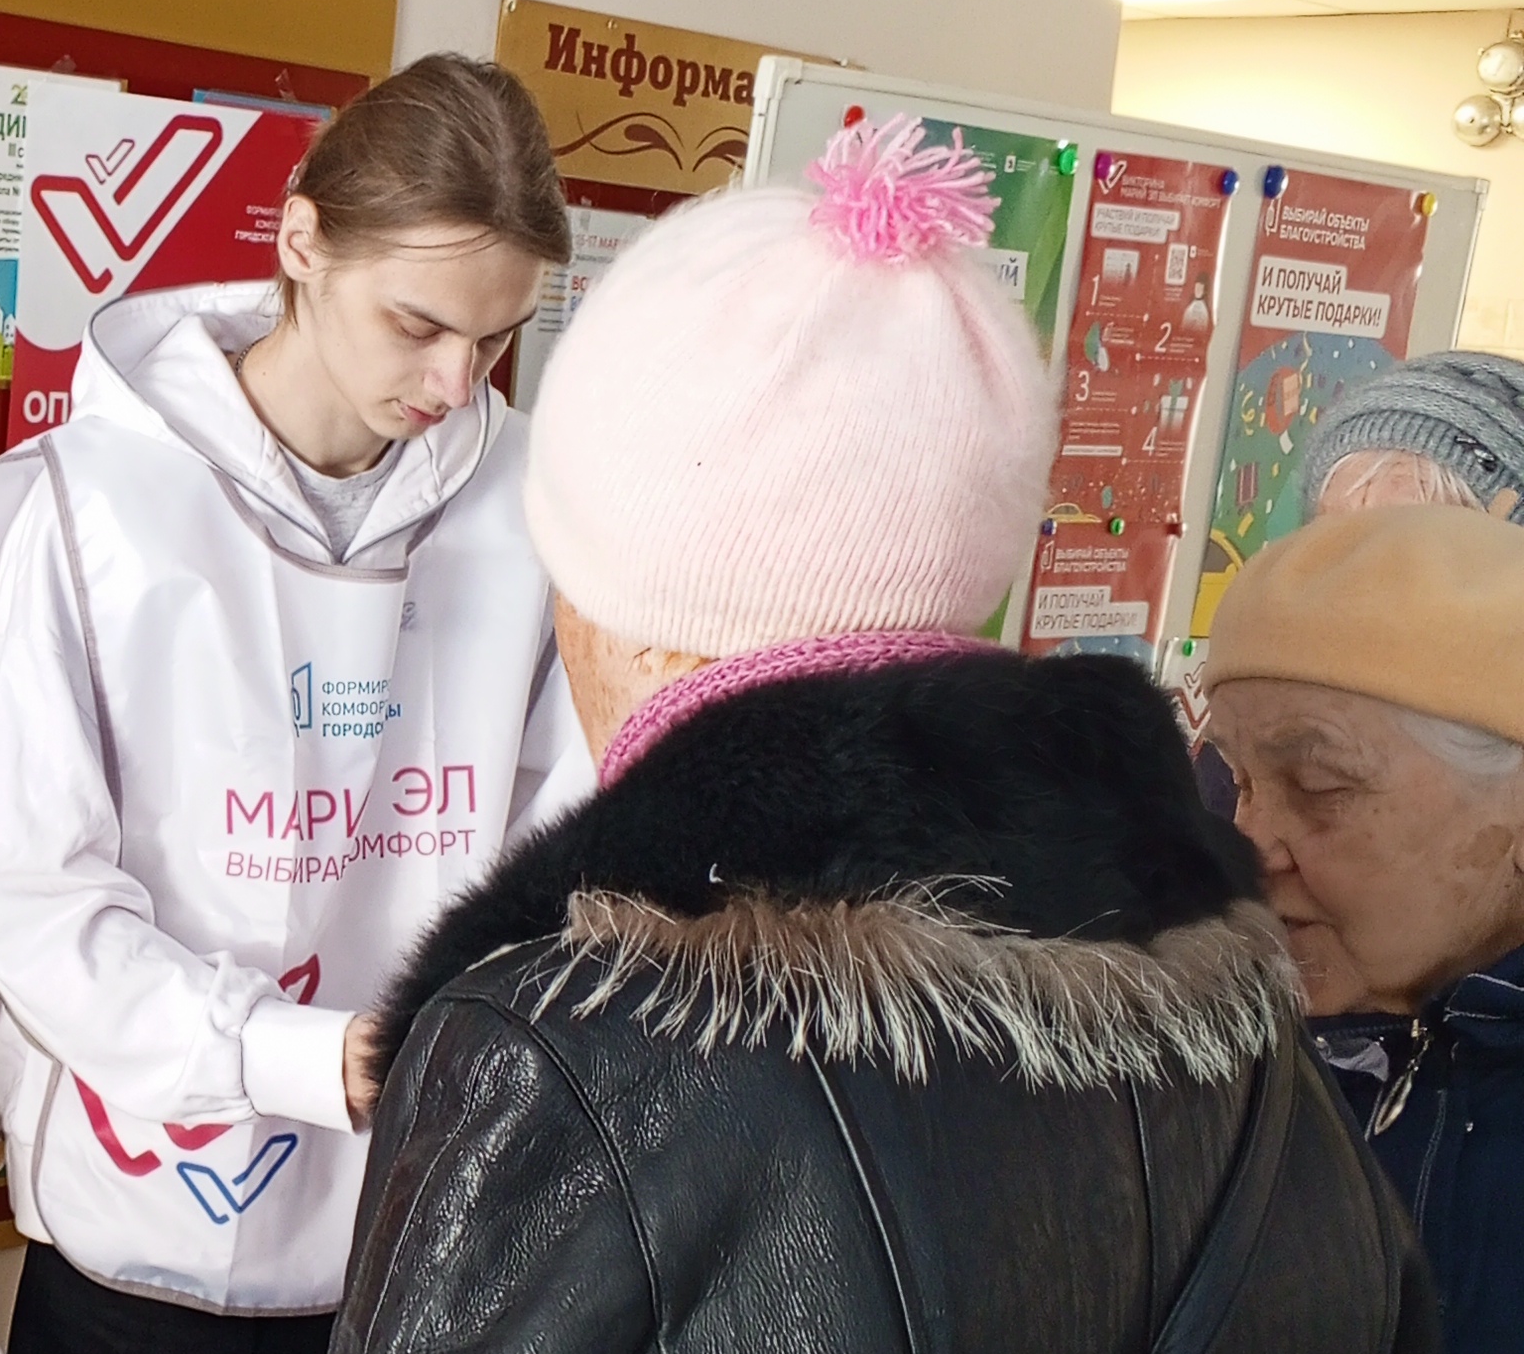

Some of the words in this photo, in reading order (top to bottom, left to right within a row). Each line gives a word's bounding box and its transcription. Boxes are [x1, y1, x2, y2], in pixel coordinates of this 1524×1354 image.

[544, 23, 755, 107] Информа
[1282, 206, 1326, 225] ВЫБИРАЙ
[1327, 212, 1370, 232] ОБЪЕКТЫ
[1279, 224, 1366, 250] БЛАГОУСТРОЙСТВА
[1262, 266, 1274, 286] И
[1277, 268, 1342, 295] ПОЛУЧАЙ
[1257, 295, 1313, 320] КРУТЫЕ
[1315, 301, 1382, 328] ПОДАРКИ!
[1154, 322, 1172, 353] 2
[1075, 370, 1090, 402] 3
[23, 390, 69, 424] ОП
[1142, 426, 1158, 457] 4
[1035, 613, 1081, 630] КРУТЫЕ
[322, 679, 390, 696] ФОРМИР
[322, 700, 386, 717] КОМФОР
[391, 764, 476, 817] ЭЛ
